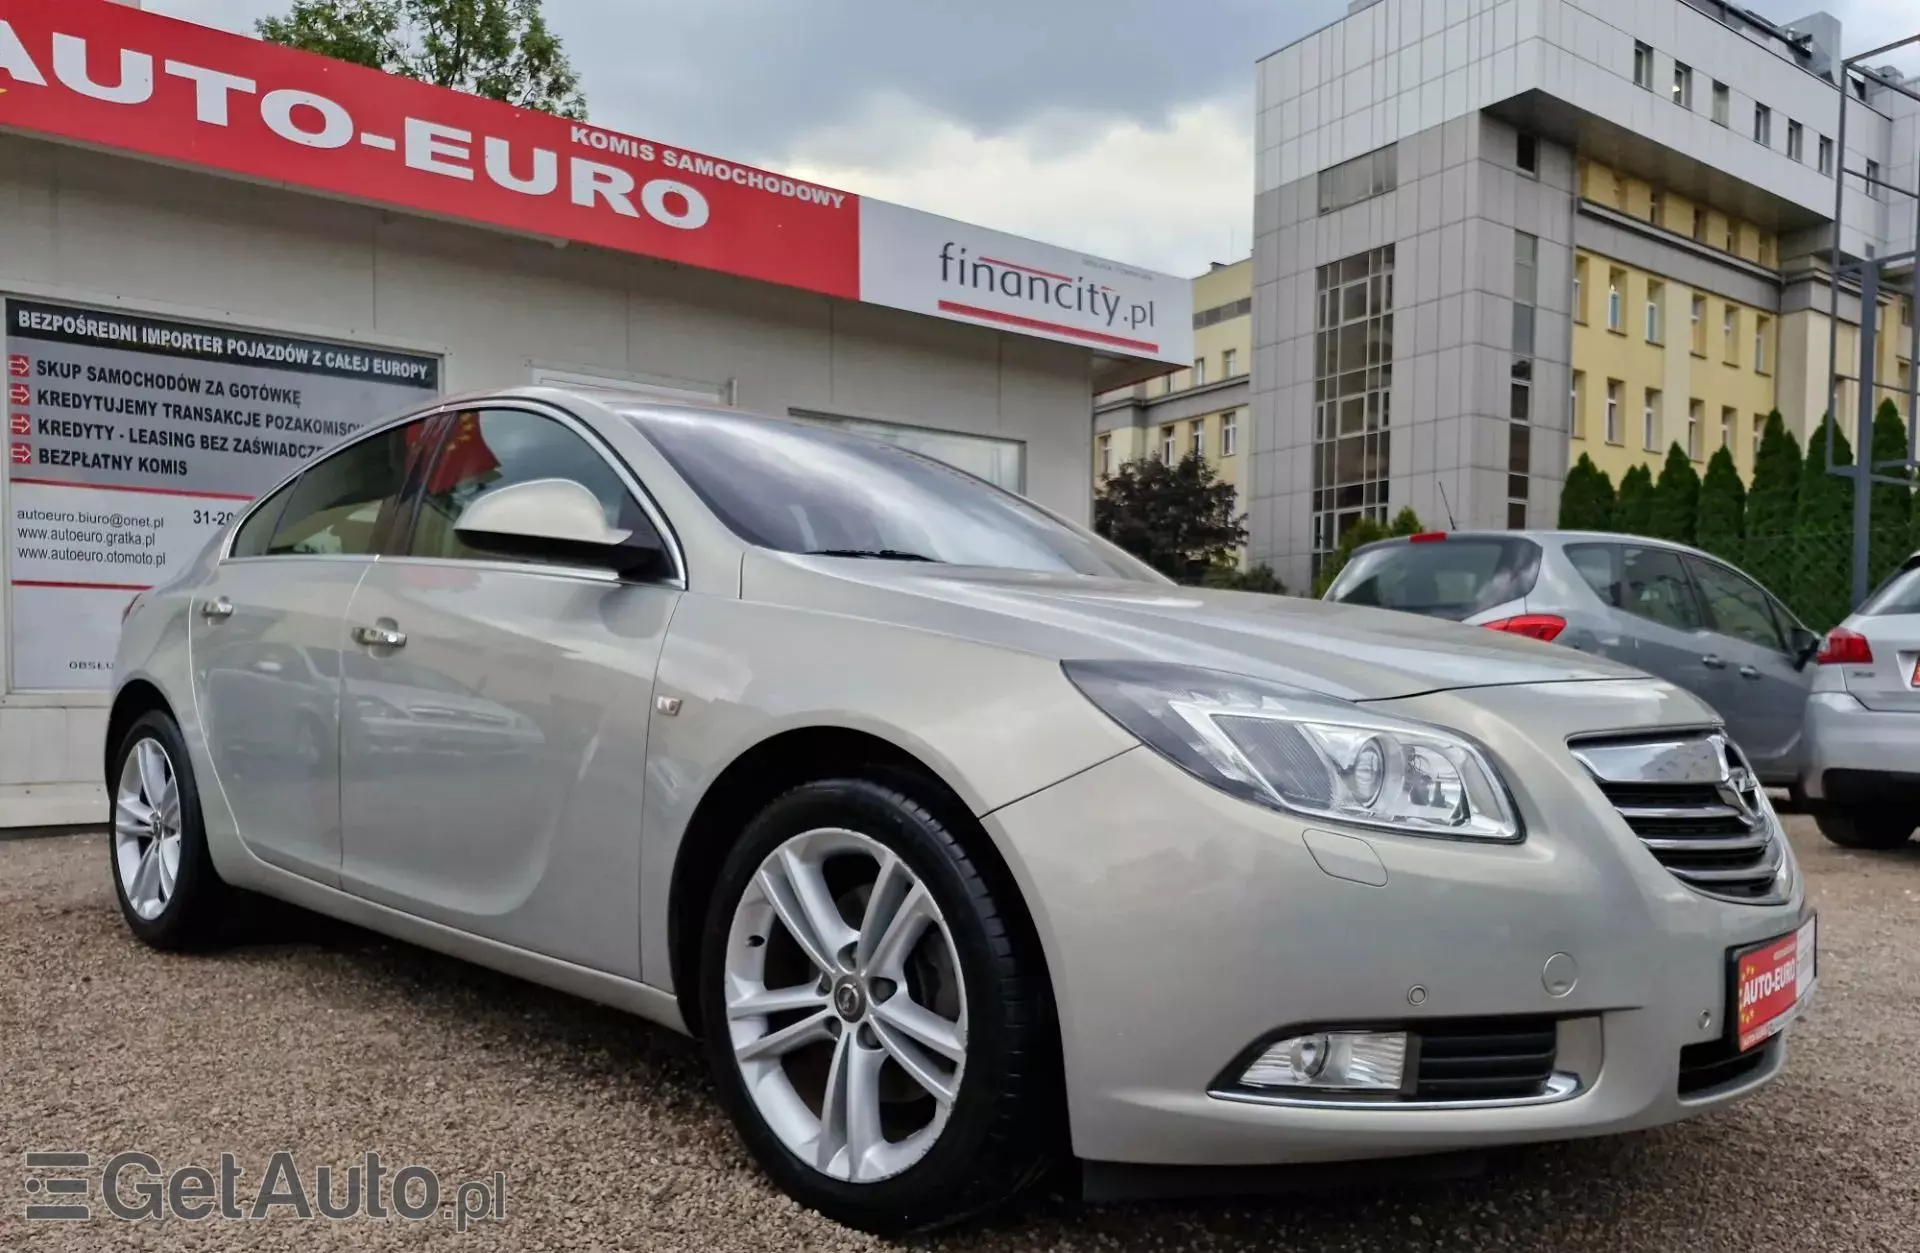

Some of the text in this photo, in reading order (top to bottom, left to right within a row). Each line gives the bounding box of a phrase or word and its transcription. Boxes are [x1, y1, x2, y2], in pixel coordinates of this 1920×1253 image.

[571, 126, 844, 208] KOMIS SAMOCHODOWY
[939, 242, 1154, 329] financity.pl
[18, 310, 427, 380] BEZPOŚREDNI IMPORTER POJAZDÓW Z CAŁEJ EUROPY
[37, 360, 302, 408] SKUP SAMOCHODÓW ZA GOTÓWKĘ
[37, 389, 365, 437] KREDYTUJEMY TRANSAKCJE POZAKOMISO
[38, 419, 115, 441] KREDYTY
[129, 428, 195, 448] LEASING
[200, 435, 229, 452] BEZ
[232, 437, 324, 458] ZAŚWIADCZ
[39, 448, 188, 476] BEZPŁATNY KOMIS
[17, 509, 164, 529] autoeuro.biuro@onet.pl
[17, 526, 156, 548] www.autoeuro.gratka.pl
[17, 547, 166, 568] www.autoeuro.otomoto.pl
[1744, 959, 1796, 1007] AUTO-EURO
